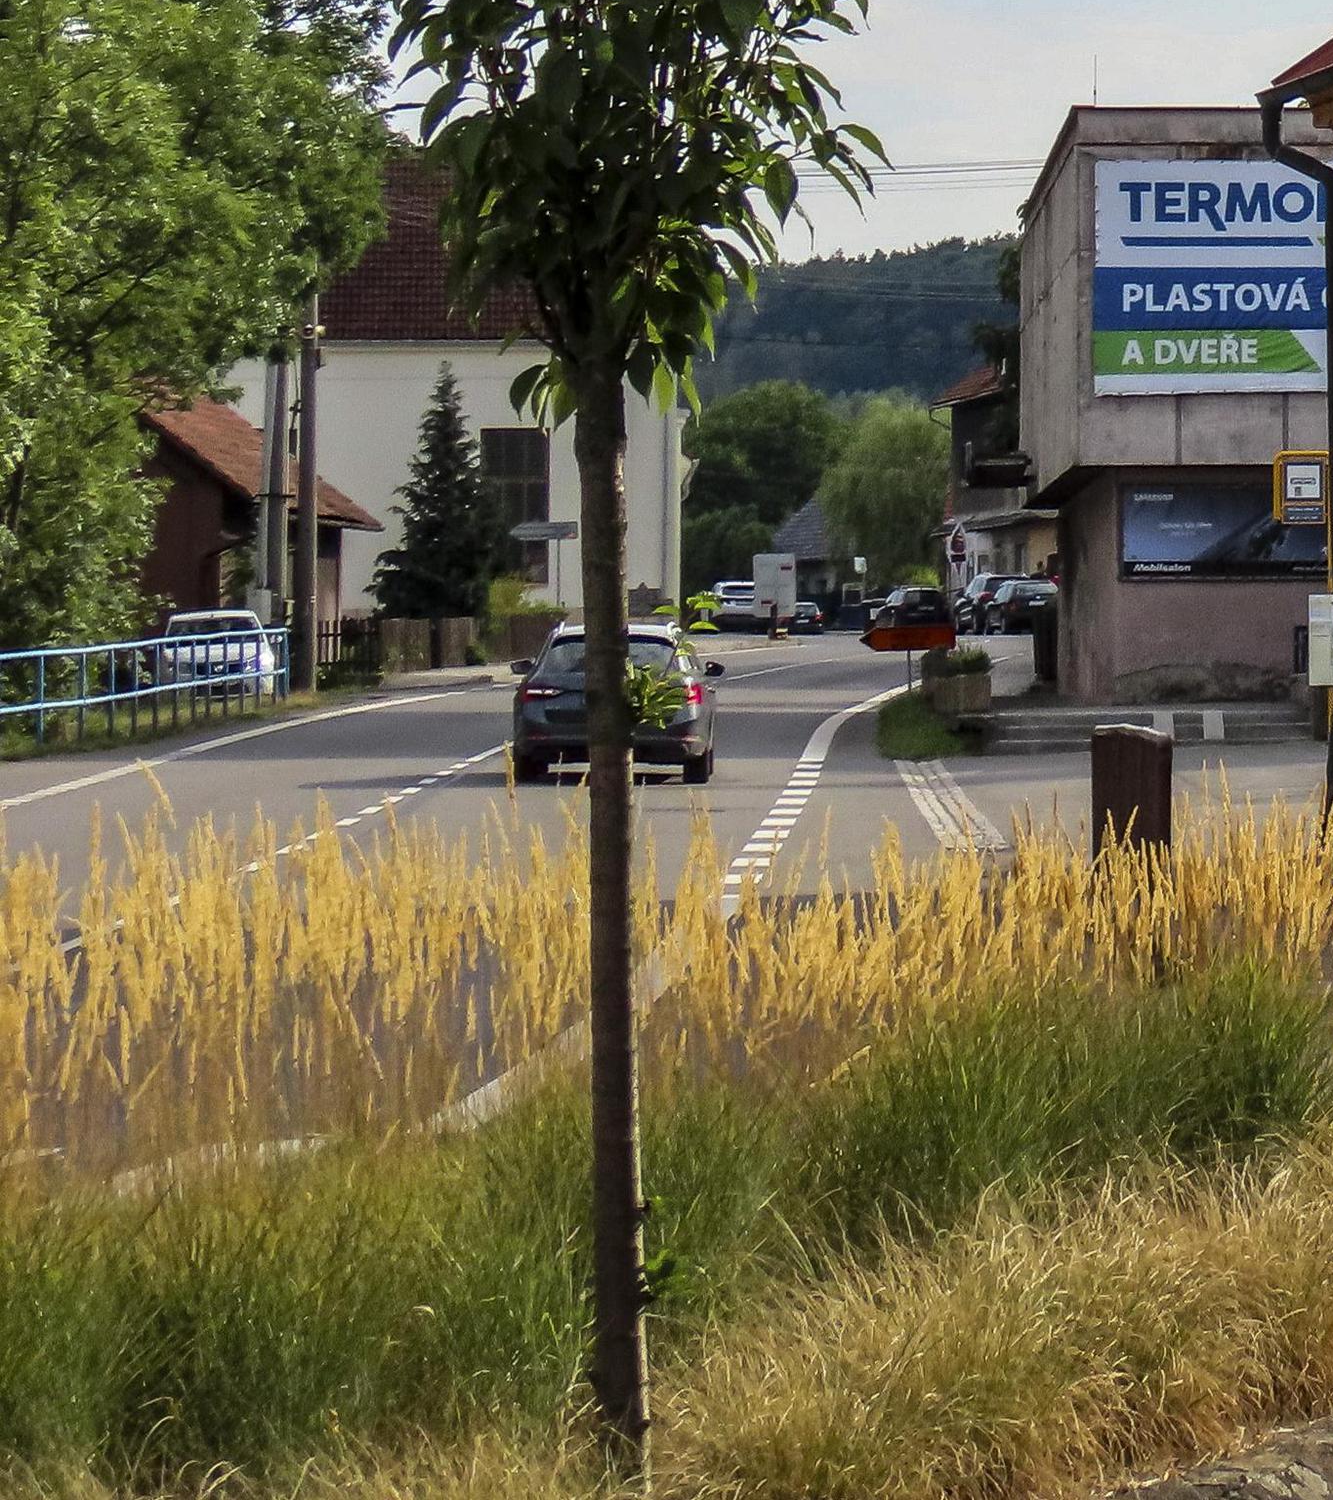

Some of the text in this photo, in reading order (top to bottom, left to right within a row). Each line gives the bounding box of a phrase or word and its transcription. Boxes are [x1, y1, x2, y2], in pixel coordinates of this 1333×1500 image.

[1119, 181, 1327, 231] TERMO
[1121, 276, 1311, 312] PLASTOVÁ
[1121, 333, 1259, 365] A DVEŘE
